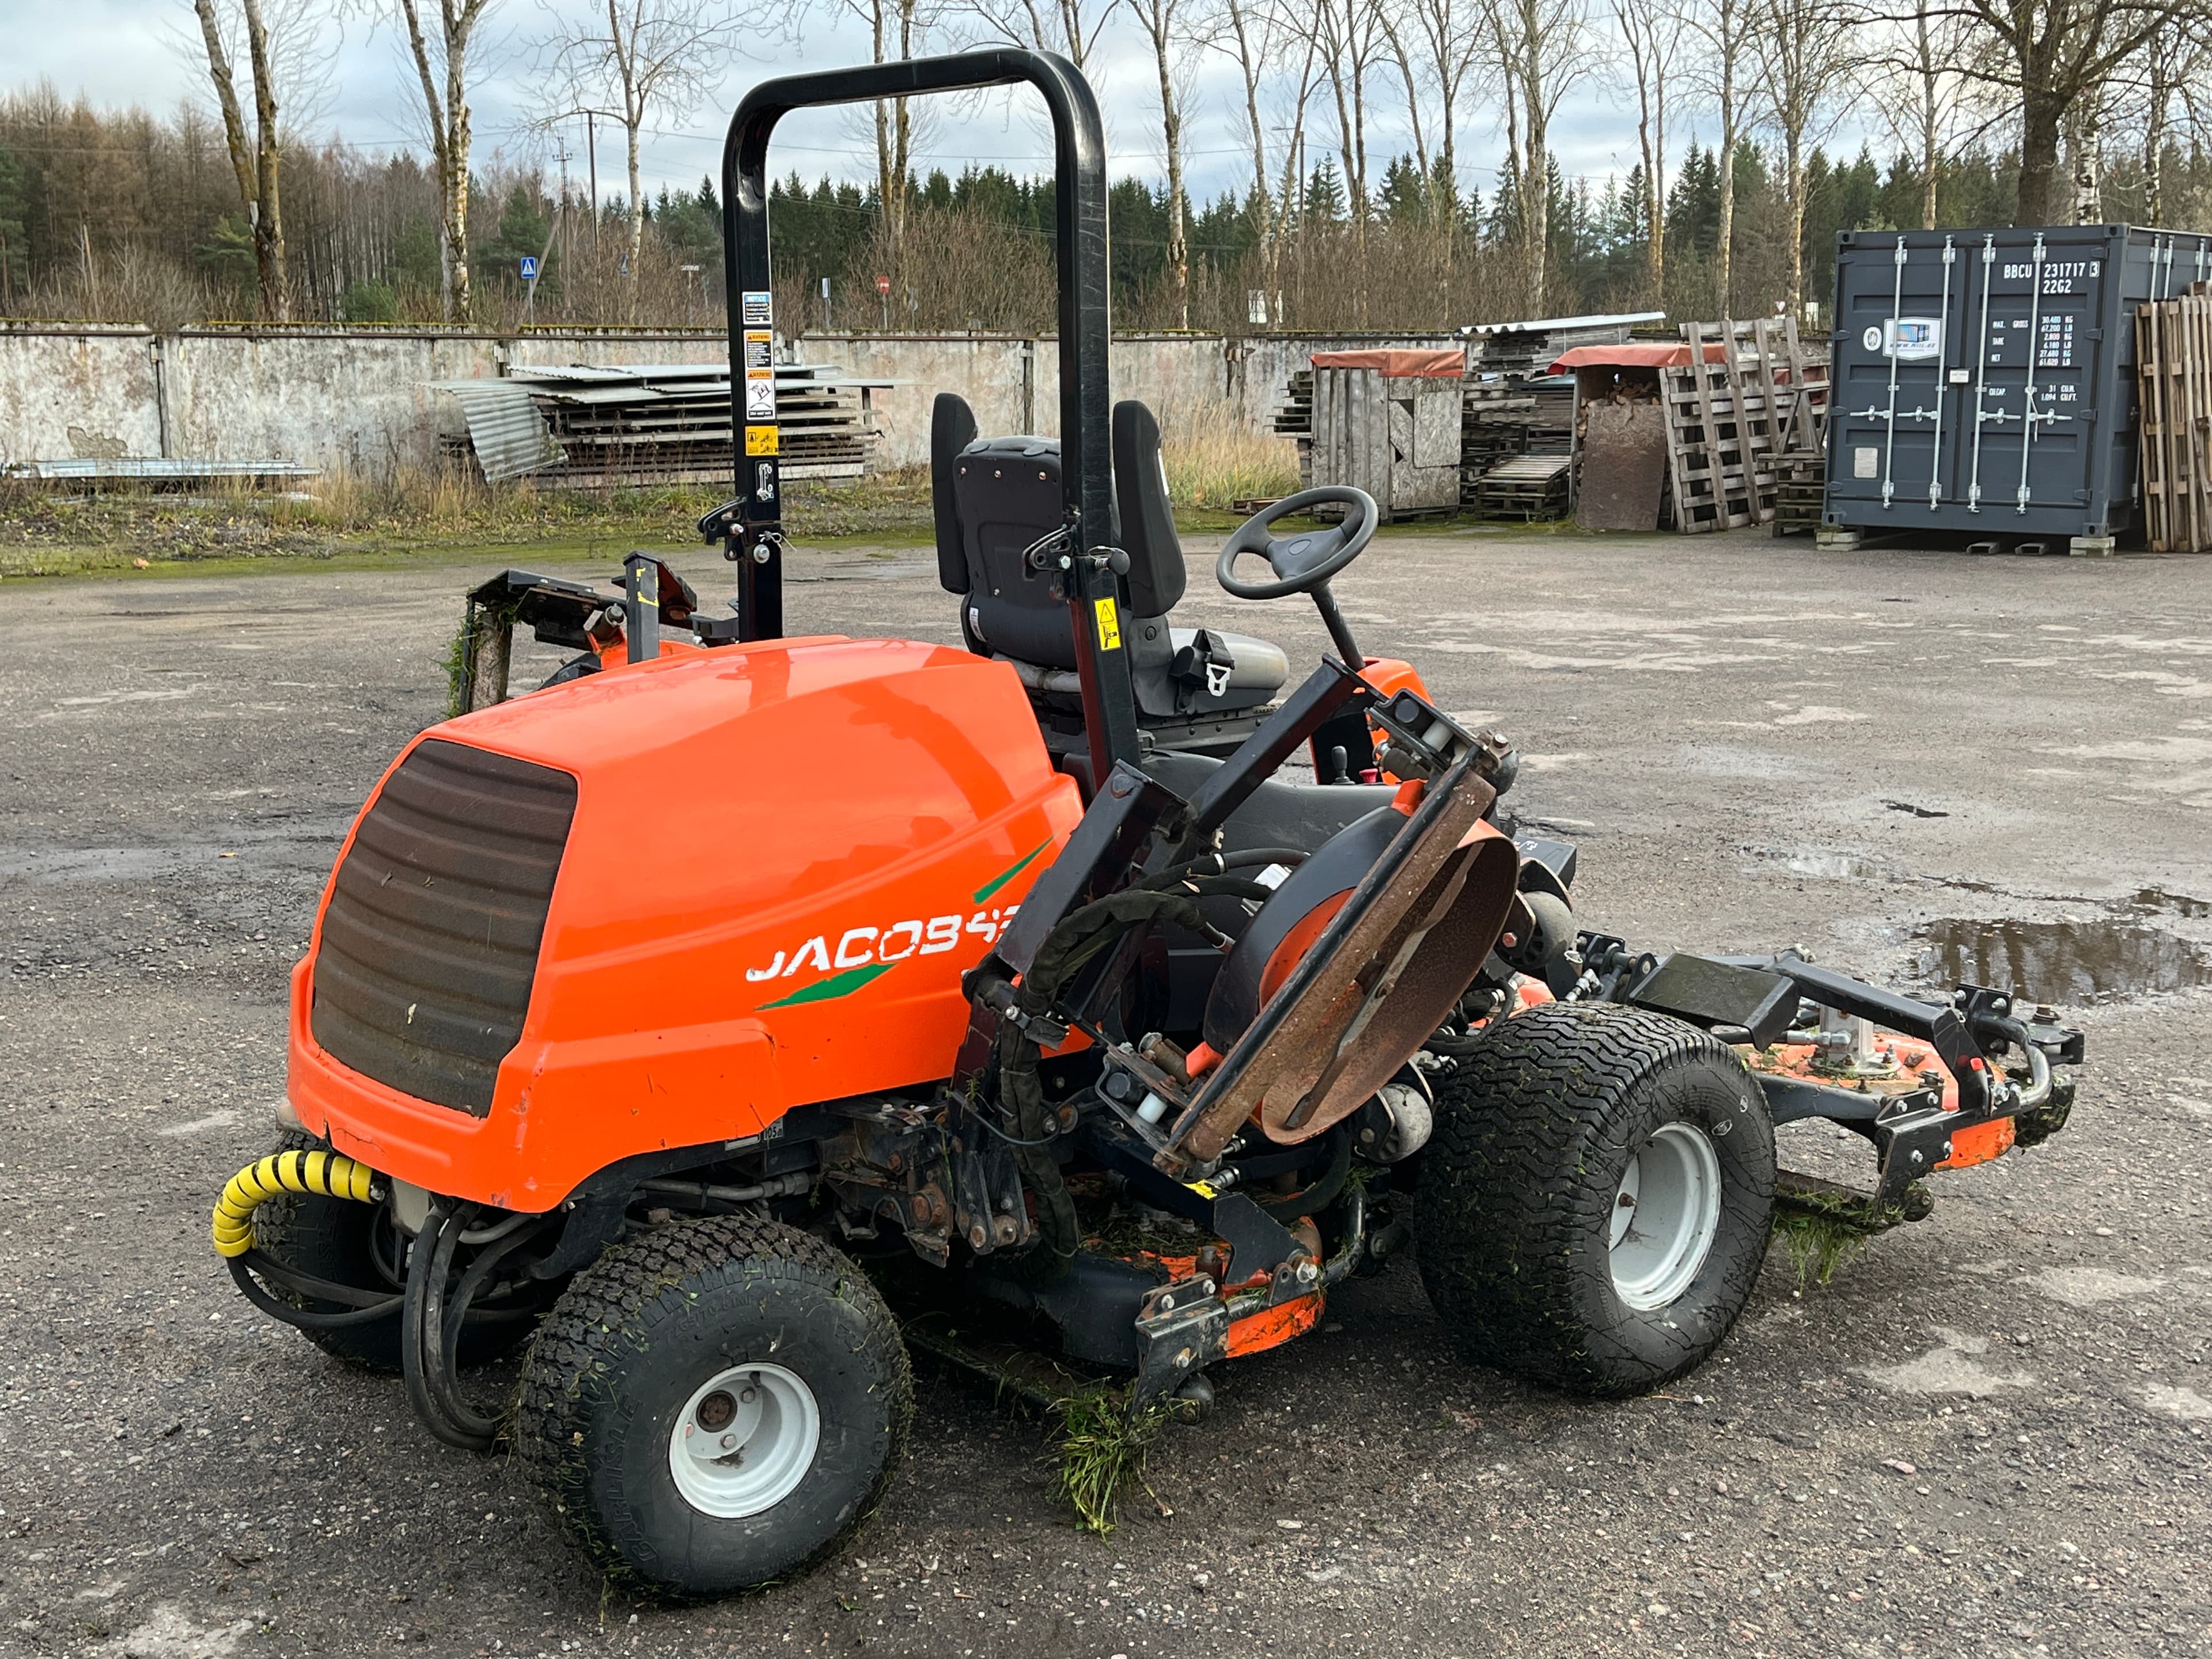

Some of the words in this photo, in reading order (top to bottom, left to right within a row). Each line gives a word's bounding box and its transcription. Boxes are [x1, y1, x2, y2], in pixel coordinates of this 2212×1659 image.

[2003, 263, 2033, 279] BBCU
[2044, 262, 2086, 278] 231717
[2090, 262, 2099, 276] 3
[2043, 279, 2072, 294] 22G2
[2065, 315, 2074, 323] KG
[2013, 320, 2029, 328] GROSS
[2064, 324, 2073, 332] LB
[1992, 337, 2005, 346] TARE
[1991, 354, 2001, 362] NET
[604, 1392, 658, 1563] CARLISLE
